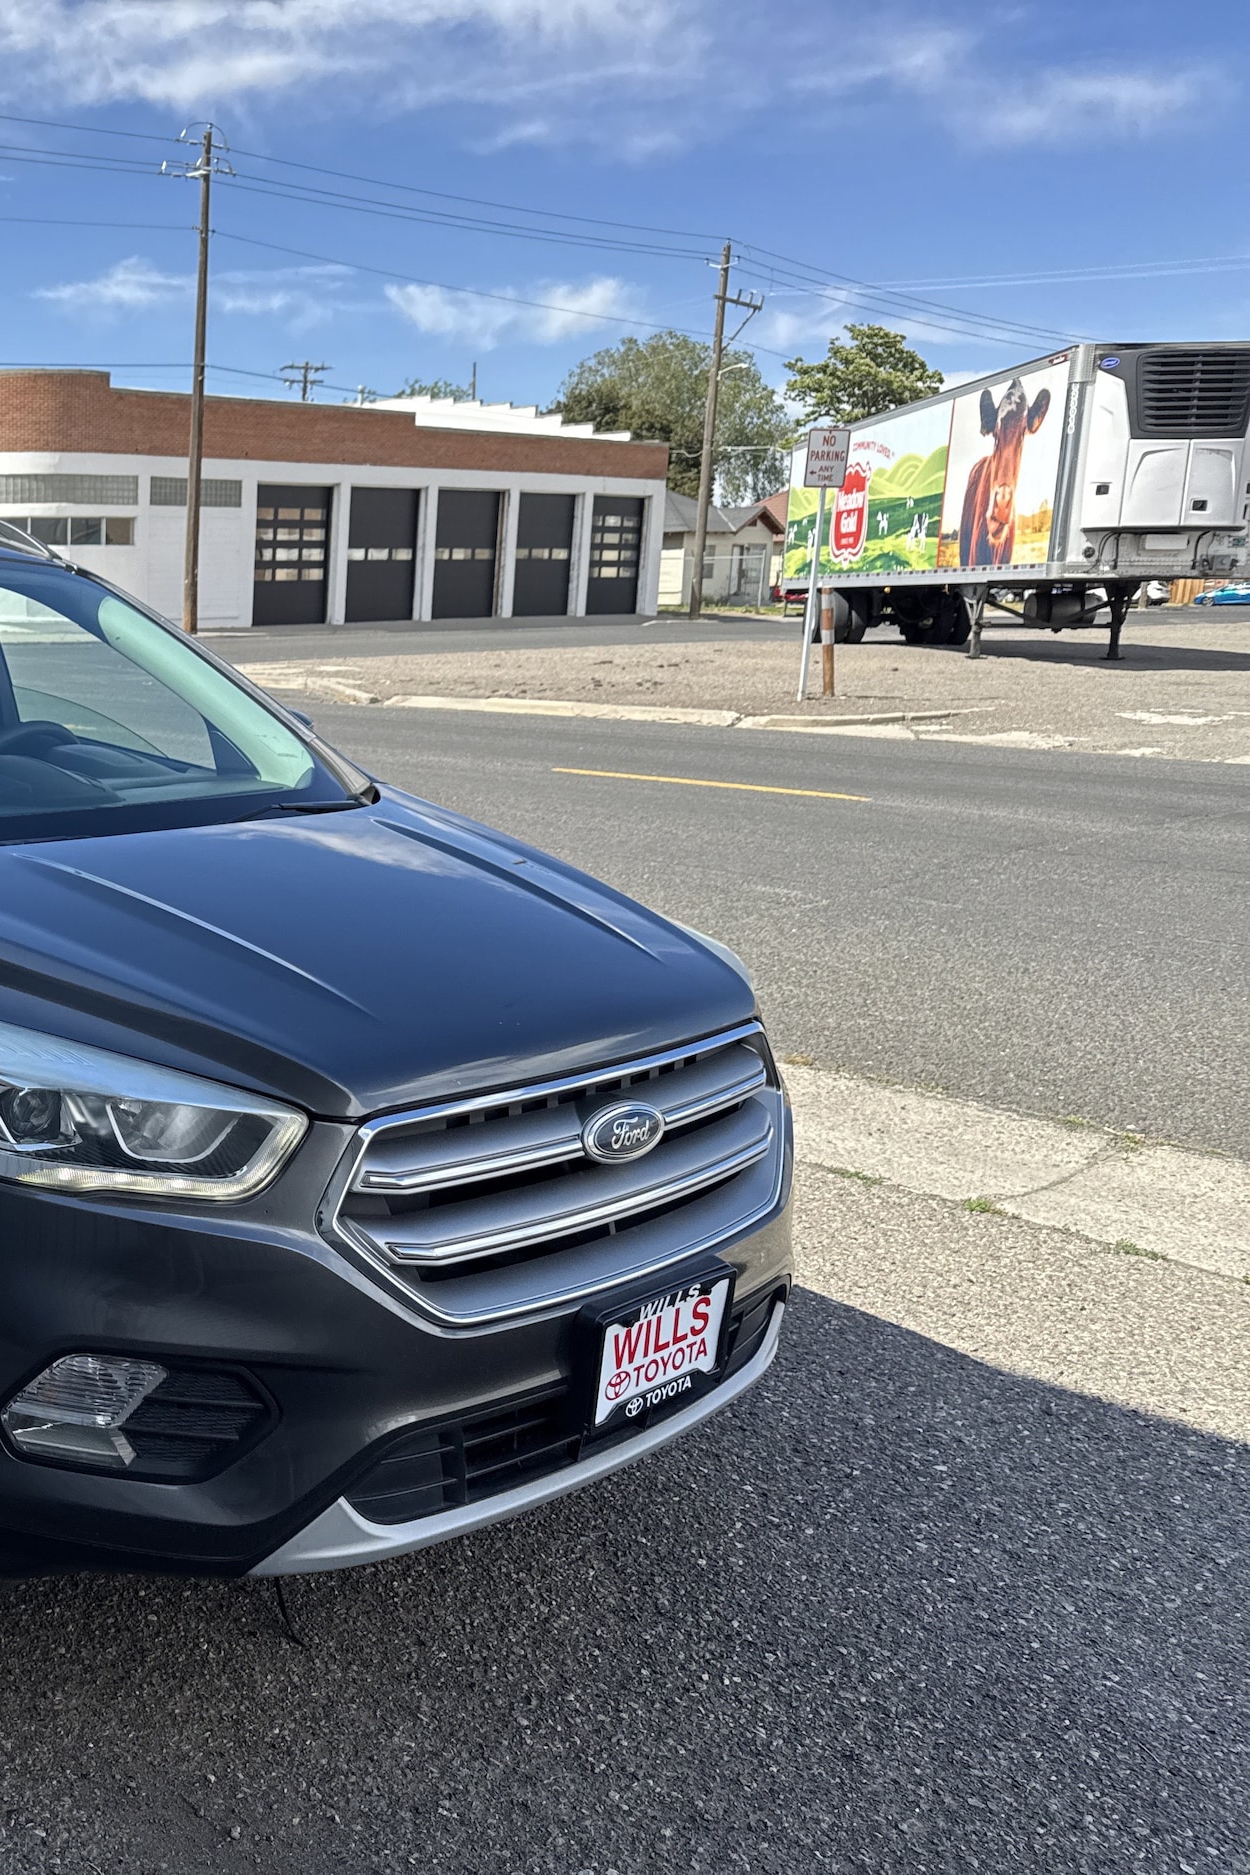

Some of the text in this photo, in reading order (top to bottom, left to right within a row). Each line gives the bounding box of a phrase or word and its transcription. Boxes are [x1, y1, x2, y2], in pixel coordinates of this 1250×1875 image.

[822, 435, 837, 447] NO
[810, 450, 846, 462] PARKING
[818, 465, 835, 473] ANY
[817, 474, 834, 482] TIME
[840, 510, 858, 534] Gold
[611, 1116, 651, 1150] Ford
[639, 1283, 702, 1321] WILLS
[613, 1296, 711, 1370] WILLS
[633, 1337, 708, 1388] TOYOTA
[646, 1375, 692, 1407] TOYOTA
